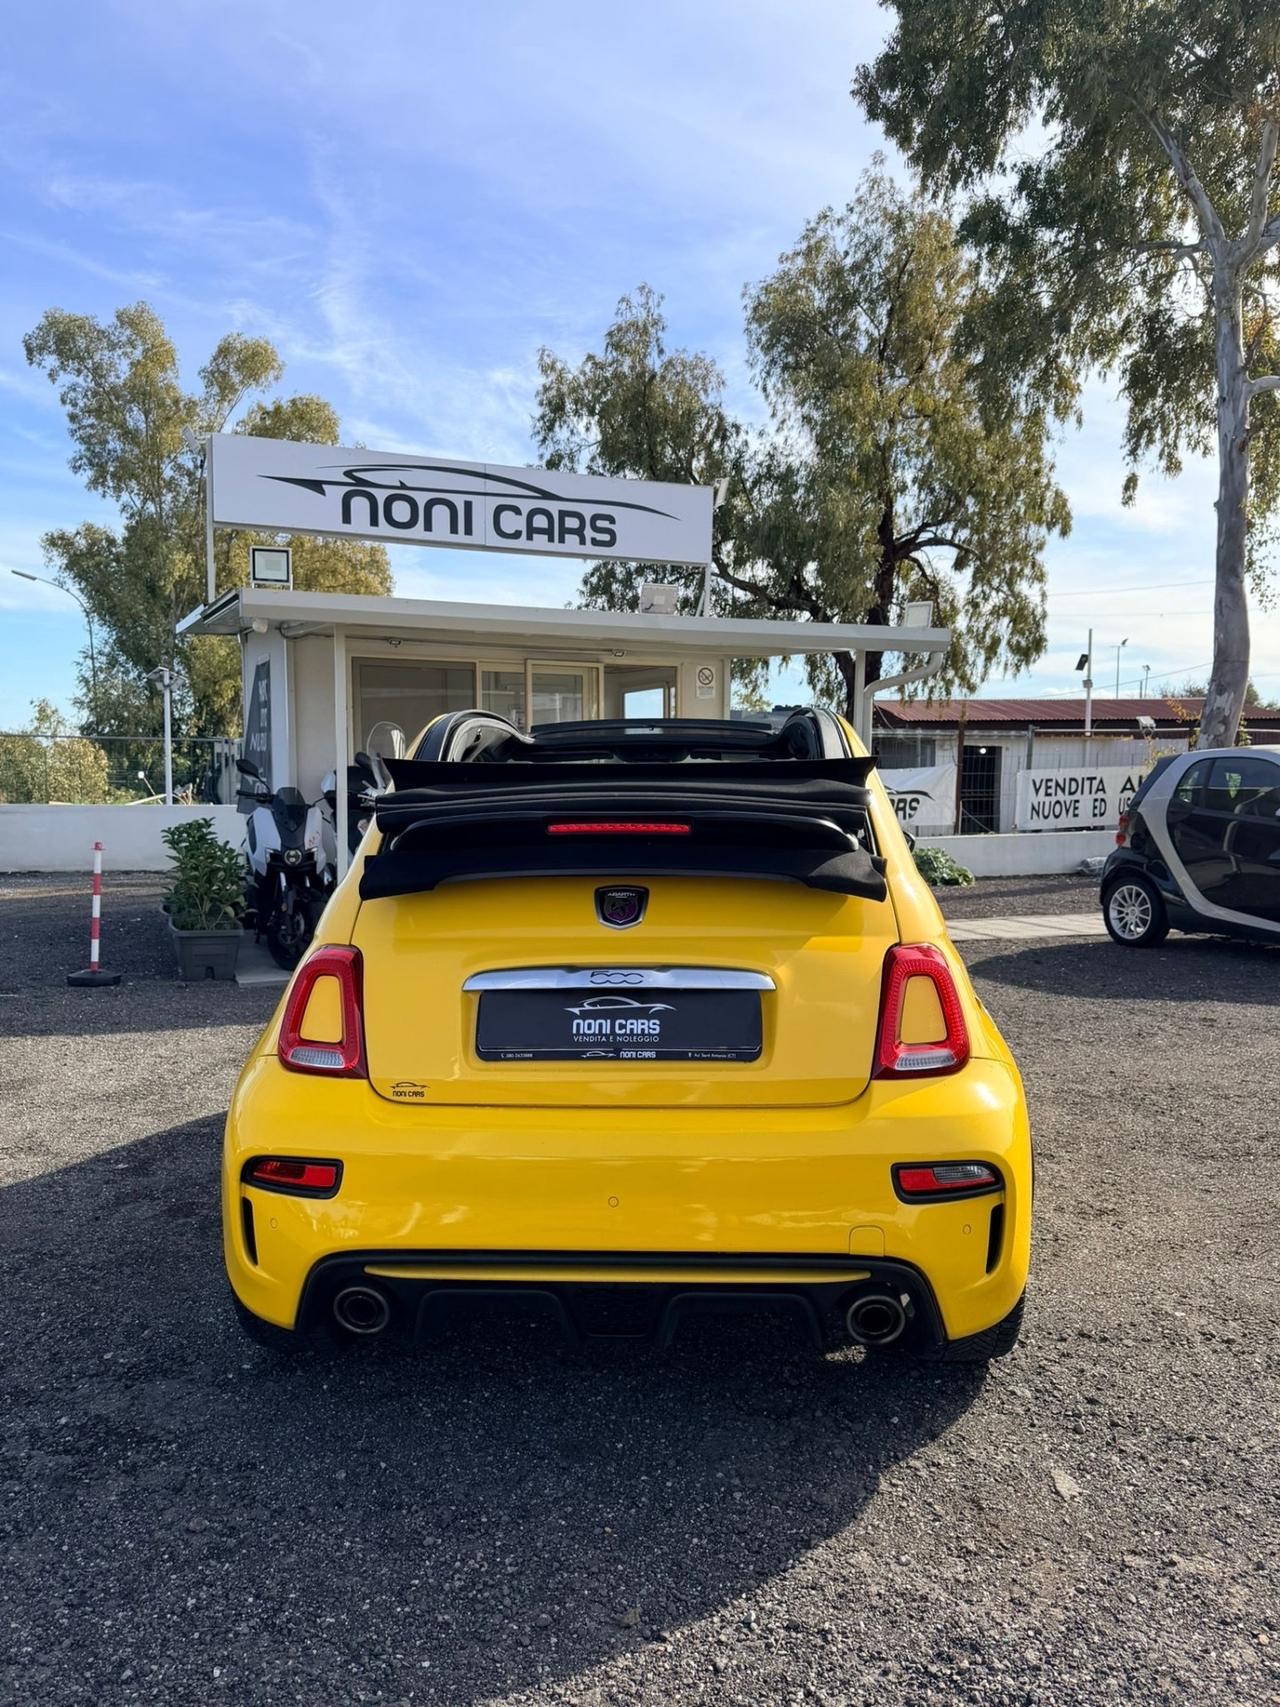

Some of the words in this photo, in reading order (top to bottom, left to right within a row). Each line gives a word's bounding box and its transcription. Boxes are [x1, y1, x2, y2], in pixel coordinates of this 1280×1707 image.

[341, 488, 473, 536] NONI
[492, 504, 617, 548] CARS
[1032, 776, 1106, 797] VENDITA
[1030, 799, 1080, 820] NUOVE
[1092, 798, 1107, 818] ED
[1118, 797, 1132, 815] US
[590, 970, 644, 985] 500
[572, 1019, 611, 1034] NONI
[615, 1019, 660, 1034] CARS
[573, 1035, 607, 1043] VENDITA
[616, 1035, 660, 1043] NOLEGGIO
[407, 1090, 425, 1098] CARS
